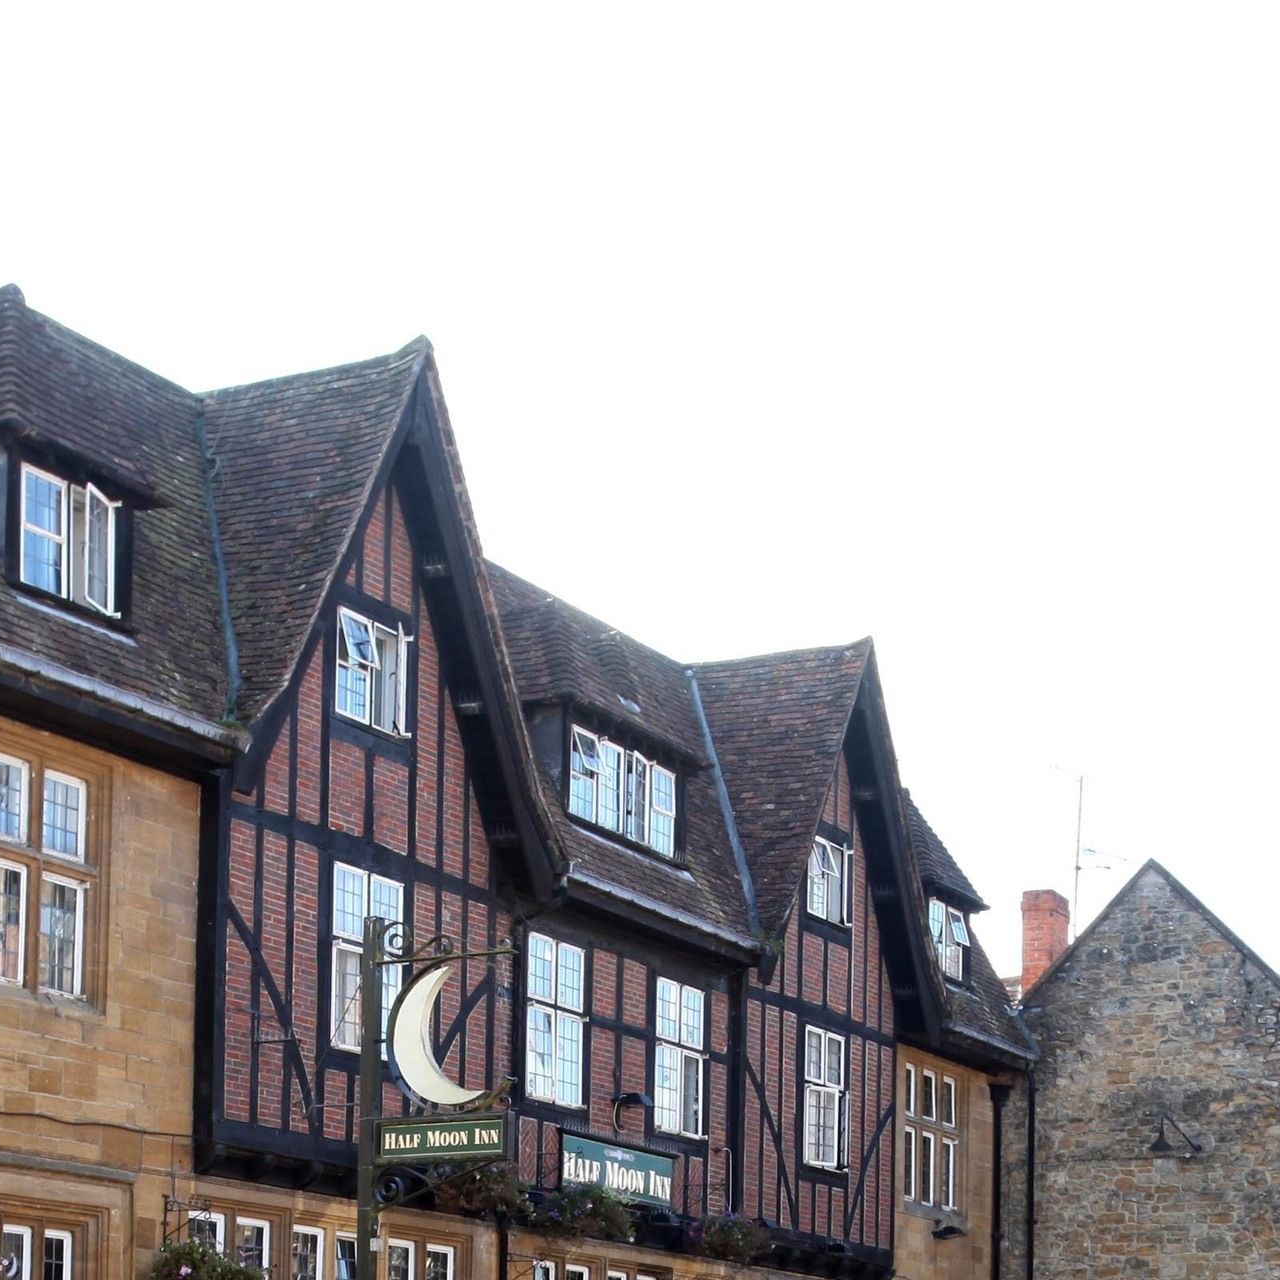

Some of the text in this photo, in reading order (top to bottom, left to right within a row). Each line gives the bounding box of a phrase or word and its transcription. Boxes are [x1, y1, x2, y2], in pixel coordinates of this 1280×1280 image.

[384, 1127, 499, 1150] HALF MOON INN
[562, 1152, 671, 1199] HALF MOON INN
